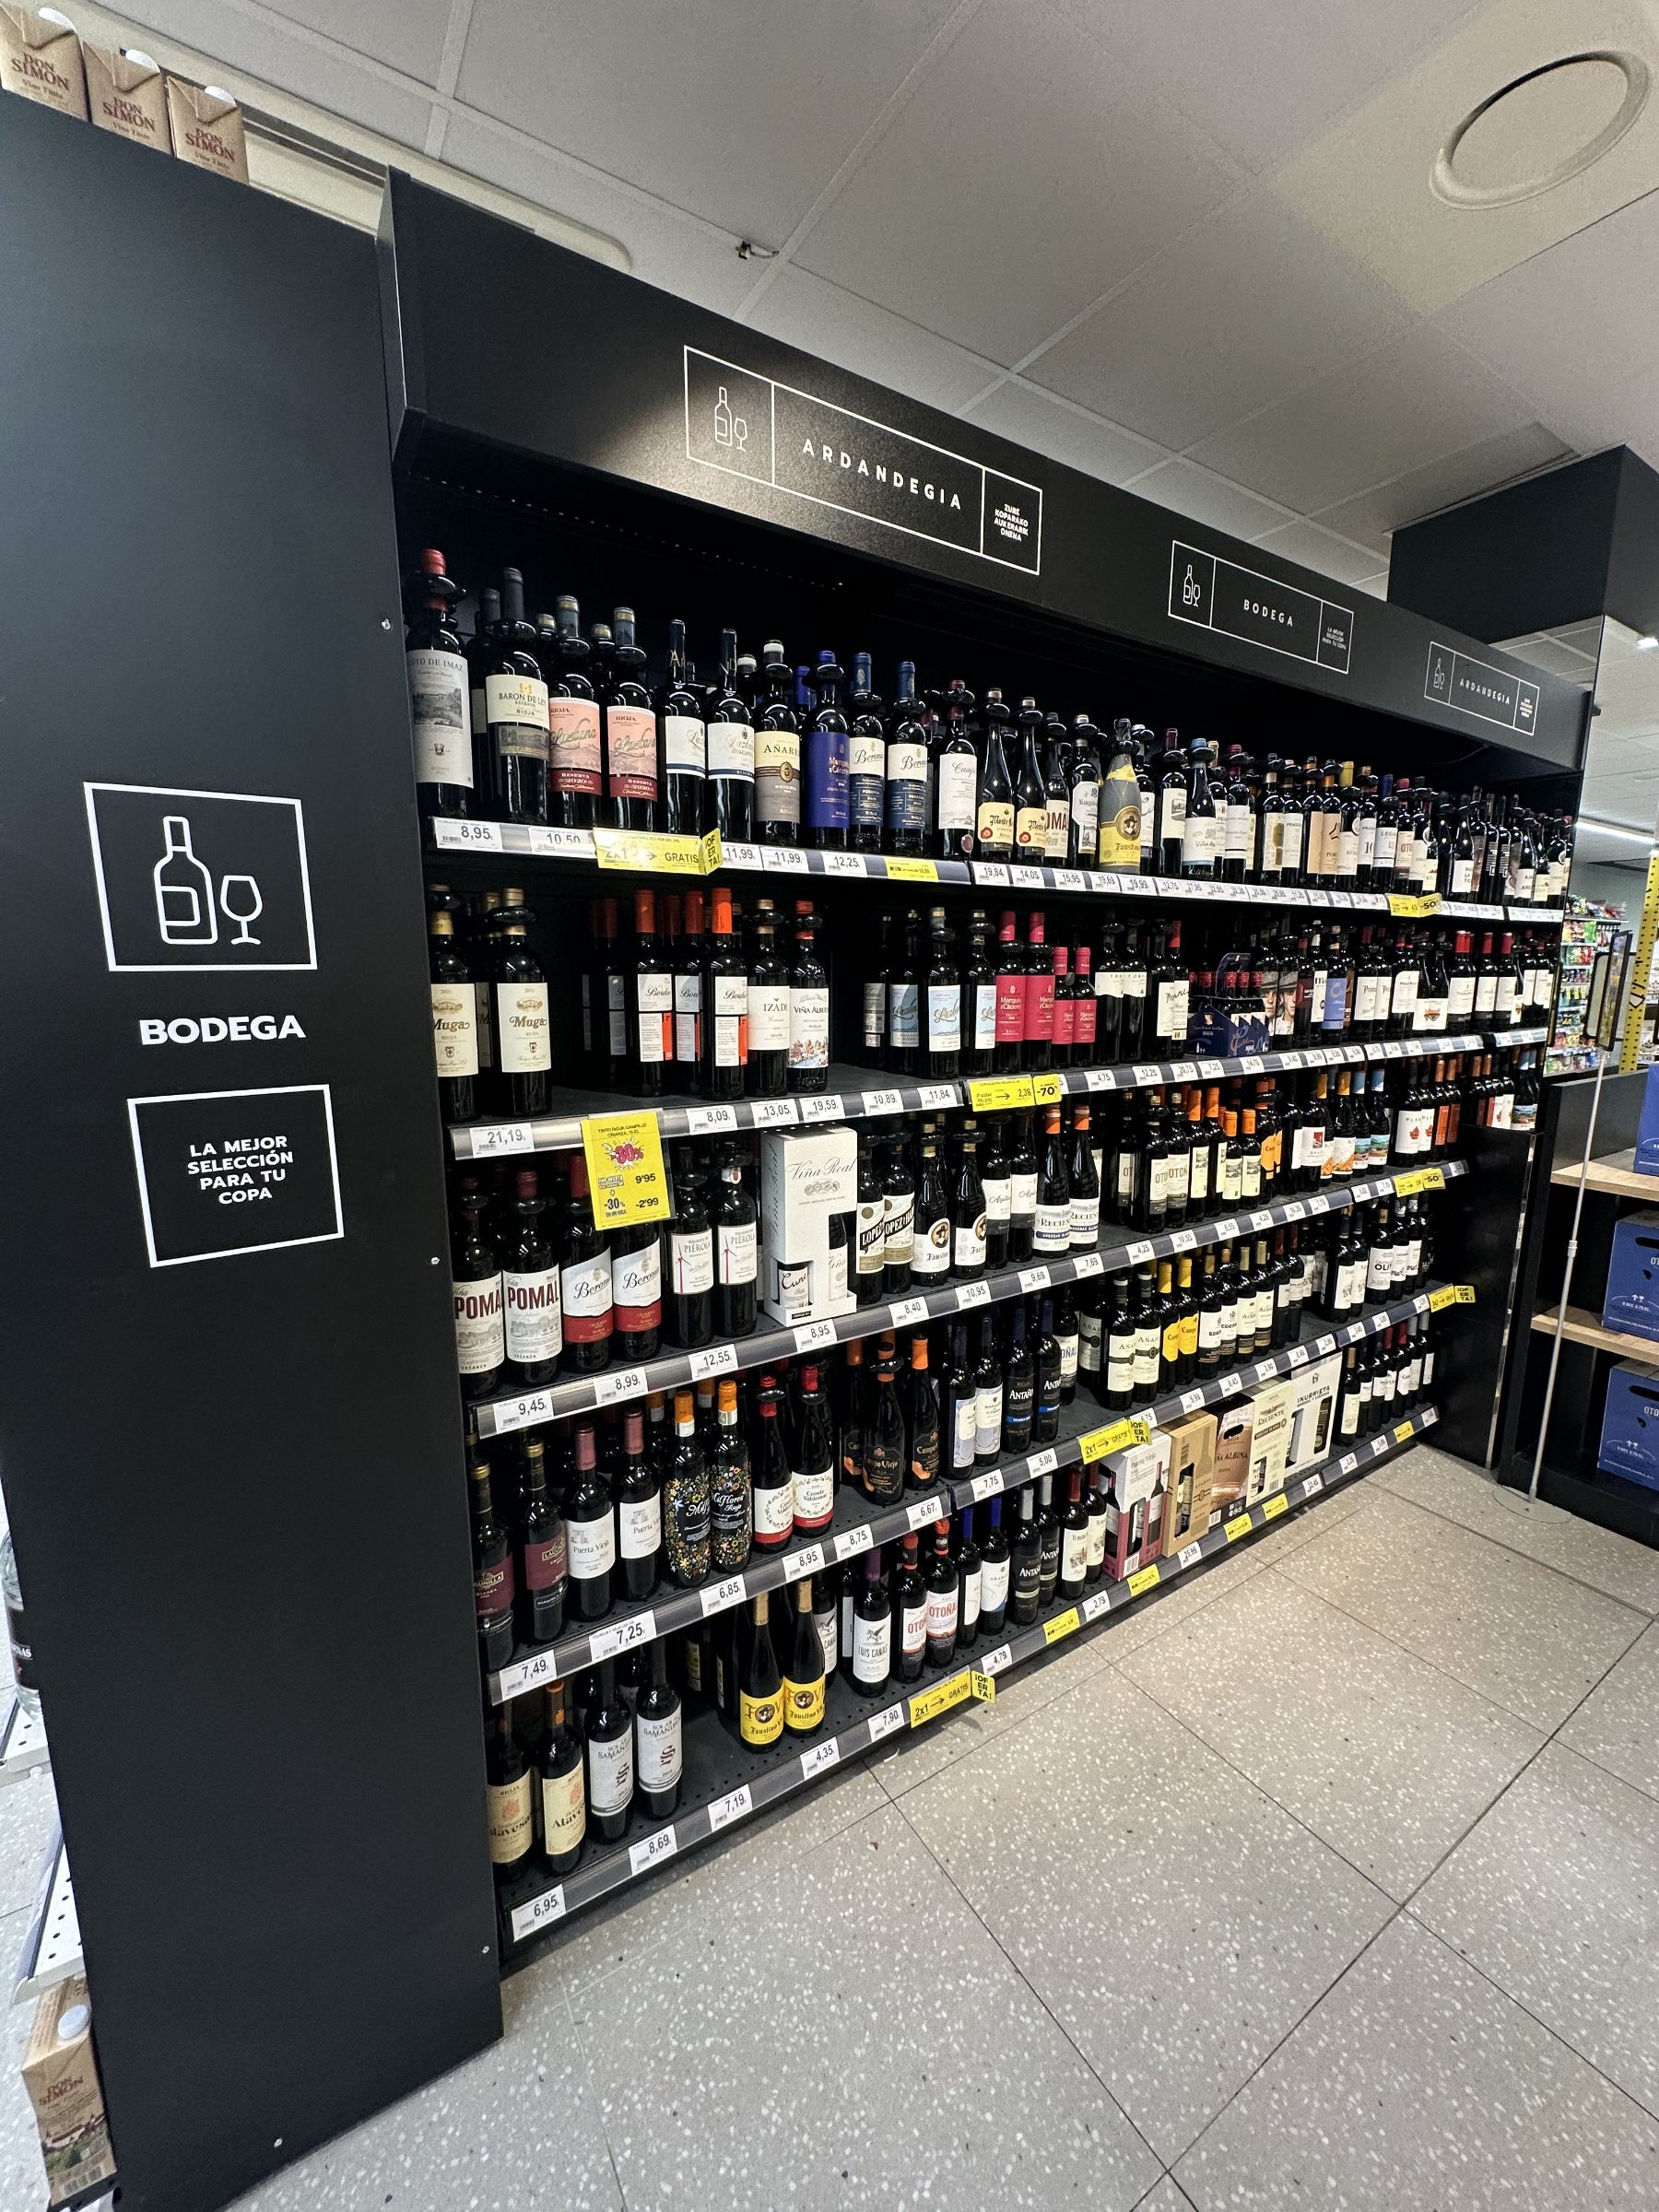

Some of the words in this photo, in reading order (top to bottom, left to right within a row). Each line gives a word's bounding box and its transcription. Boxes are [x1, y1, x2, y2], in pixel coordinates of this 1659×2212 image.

[23, 53, 54, 73] DON
[11, 57, 69, 90] SIMON
[113, 97, 142, 114] DON
[103, 103, 155, 131] SIMON
[195, 128, 223, 146] DON
[185, 133, 235, 161] SIMON
[803, 439, 961, 510] ARDANDEGIA
[1004, 503, 1021, 516] ZUBE
[994, 509, 1029, 527] KOPARAKO
[994, 517, 1029, 536] AUKERARIK
[1000, 527, 1022, 542] ONENA
[1243, 599, 1294, 627] BODEGA
[428, 658, 441, 667] DE
[443, 660, 464, 672] IMAZ
[1460, 677, 1511, 705] ARDANDEGIA
[499, 692, 526, 701] BARON
[537, 697, 547, 707] LEY
[461, 826, 490, 841] 8,95
[665, 852, 700, 864] GRATIS
[708, 847, 716, 857] ER
[725, 847, 755, 861] 11,99
[774, 851, 801, 864] 11,99
[834, 856, 859, 868] 12,25
[983, 866, 1004, 877] 19,84
[1063, 875, 1081, 883] 15,95
[794, 1006, 810, 1014] VIÑA
[434, 1018, 470, 1032] Muga
[509, 1016, 547, 1028] Muga
[139, 1015, 305, 1045] BODEGA
[1098, 1073, 1111, 1082] 4,75
[873, 1093, 896, 1105] 10,89
[928, 1088, 948, 1100] 11,84
[763, 1104, 790, 1117] 13,05
[811, 1100, 837, 1112] 19,59
[707, 1110, 728, 1123] 8,09
[488, 1129, 524, 1145] 21,19
[190, 1142, 217, 1158] LA
[224, 1135, 288, 1154] MEJOR
[187, 1149, 294, 1175] SELECCIÓN
[785, 1161, 822, 1181] Viña
[823, 1156, 858, 1175] Real
[200, 1172, 252, 1191] PARA
[260, 1169, 286, 1183] TU
[635, 1173, 656, 1183] 9'95
[218, 1187, 272, 1206] COPA
[684, 1242, 712, 1253] PIÉROLA
[1137, 1244, 1150, 1254] 4,25
[1085, 1258, 1099, 1268] 7,69
[1030, 1272, 1046, 1283] 9,69
[508, 1280, 559, 1310] POMAL
[966, 1287, 986, 1298] 10,95
[454, 1287, 502, 1320] POMA
[905, 1302, 922, 1314] 8,40
[810, 1324, 830, 1338] 8,95
[703, 1350, 731, 1367] 12,55
[615, 1373, 640, 1390] 8,99
[1297, 1385, 1331, 1404] INURRIETA
[518, 1398, 545, 1417] 9,45
[1039, 1454, 1053, 1466] 5,00
[983, 1477, 999, 1489] 7,75
[806, 1488, 826, 1498] Conde
[920, 1503, 935, 1517] 6,67
[633, 1524, 653, 1535] Puerta
[850, 1530, 867, 1546] 8,75
[573, 1545, 594, 1554] Puerta
[595, 1539, 609, 1551] Vieja
[799, 1552, 818, 1566] 8,95
[719, 1582, 740, 1598] 6,85
[1094, 1596, 1106, 1608] 2,79
[616, 1626, 642, 1645] 7,25
[857, 1645, 870, 1657] LUIS
[994, 1652, 1007, 1665] 4,79
[522, 1661, 547, 1680] 7,49
[978, 1682, 988, 1691] ER
[915, 1703, 929, 1717] 2x1
[948, 1682, 969, 1700] GRATIS
[883, 1711, 900, 1726] 7,90
[816, 1745, 834, 1761] 4,35
[724, 1794, 746, 1813] 7,19
[649, 1834, 670, 1854] 8,69
[534, 1896, 558, 1917] 6,95
